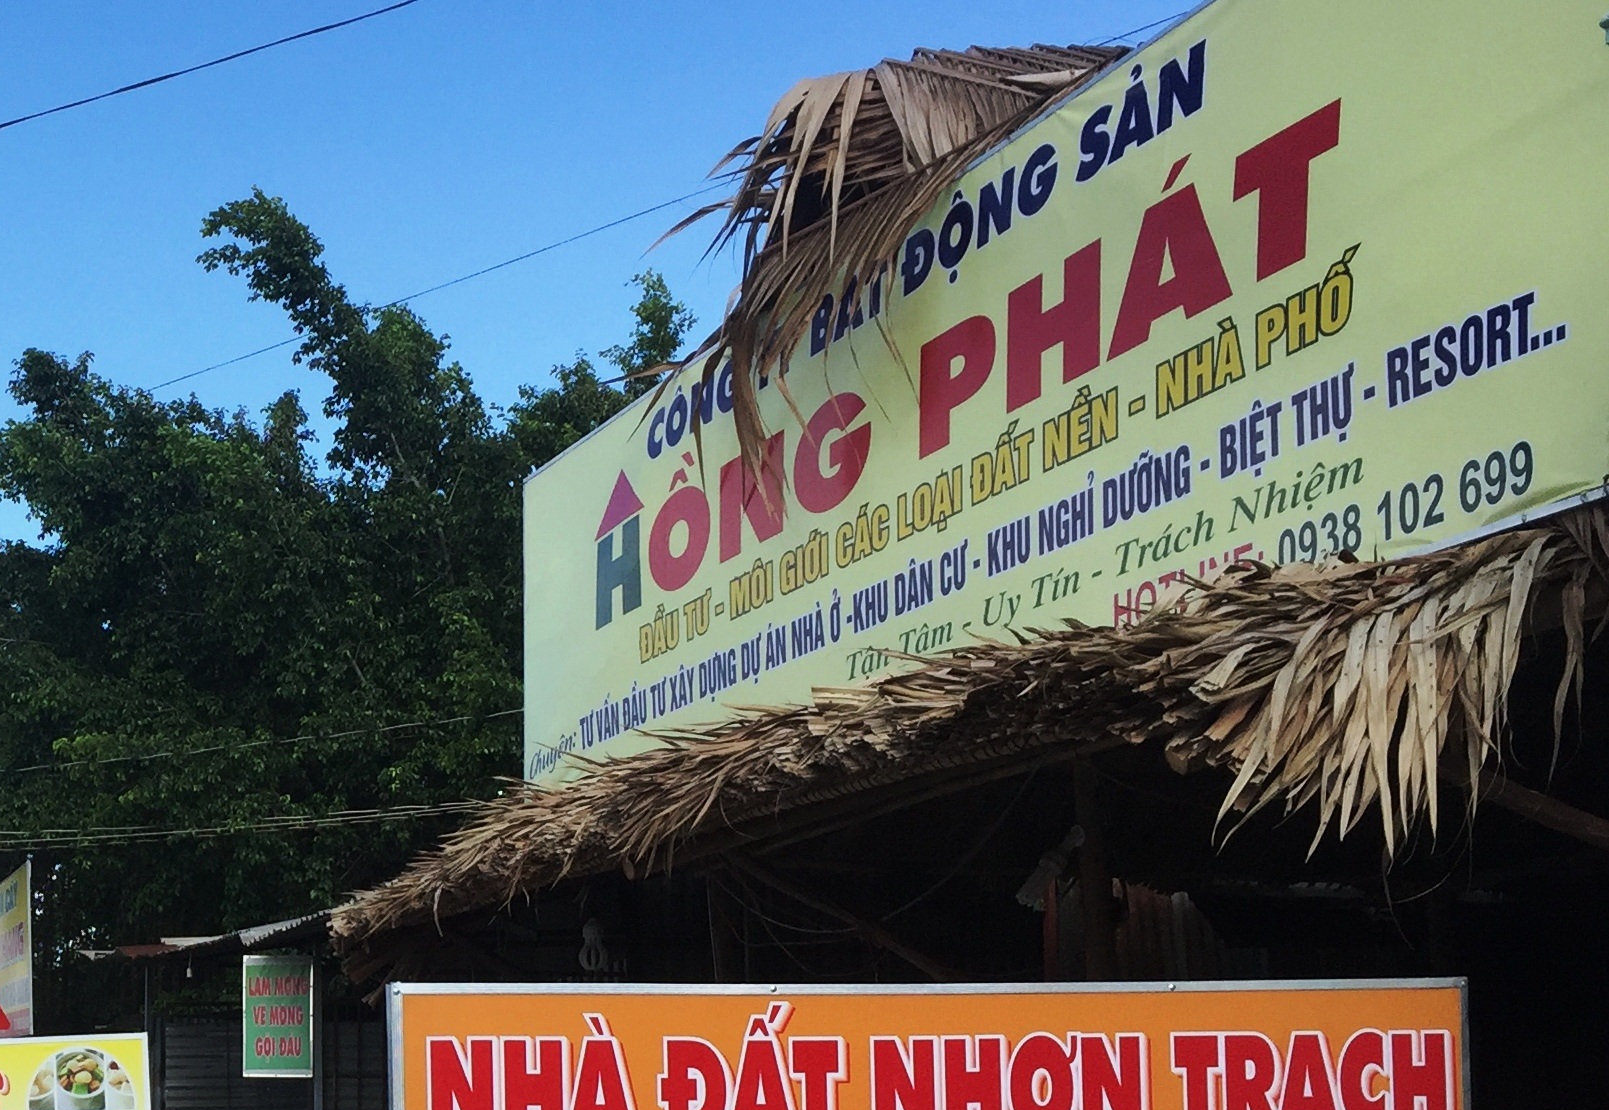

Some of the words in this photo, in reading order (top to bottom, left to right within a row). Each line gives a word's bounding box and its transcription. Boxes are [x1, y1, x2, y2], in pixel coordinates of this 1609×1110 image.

[902, 143, 1058, 297] ĐỘNG
[1075, 38, 1207, 182] SẢN
[595, 392, 872, 631] HỒNG
[919, 98, 1342, 460] PHÁT
[639, 603, 680, 664] ĐẦU
[684, 587, 712, 643] TƯ
[729, 558, 773, 621] MÔI
[779, 528, 829, 596] GIỚI
[835, 502, 890, 569] CÁC
[897, 464, 963, 542] LOẠI
[969, 418, 1035, 507] ĐẤT
[1042, 384, 1119, 474] NỀN
[1155, 316, 1246, 420] NHÀ
[1254, 241, 1362, 371] PHỐ
[1278, 502, 1362, 564] 0938
[1377, 473, 1445, 542] 102
[1459, 440, 1534, 514] 699
[579, 709, 595, 750] TƯ
[596, 692, 620, 744] VẤN
[622, 679, 647, 732] ĐẦU
[649, 680, 668, 720] TƯ
[669, 664, 694, 714] XÂY
[698, 647, 737, 703] DỰNG
[741, 632, 762, 684] DỰ
[765, 622, 787, 672] ÁN
[791, 600, 825, 660] NHÀ
[829, 588, 841, 643] Ở
[894, 557, 934, 617] DÂN
[941, 538, 968, 597] CƯ
[987, 514, 1031, 578] KHU
[1038, 470, 1095, 556] NGHỈ
[1102, 444, 1192, 530] DƯỠNG
[1219, 399, 1282, 479] BIỆT
[1290, 361, 1355, 447] THỰ
[899, 619, 954, 654] Tâm
[984, 588, 1022, 629] Uy
[1030, 565, 1081, 609] Tín
[1115, 510, 1215, 577] Trách
[1227, 456, 1364, 534] Nhiệm
